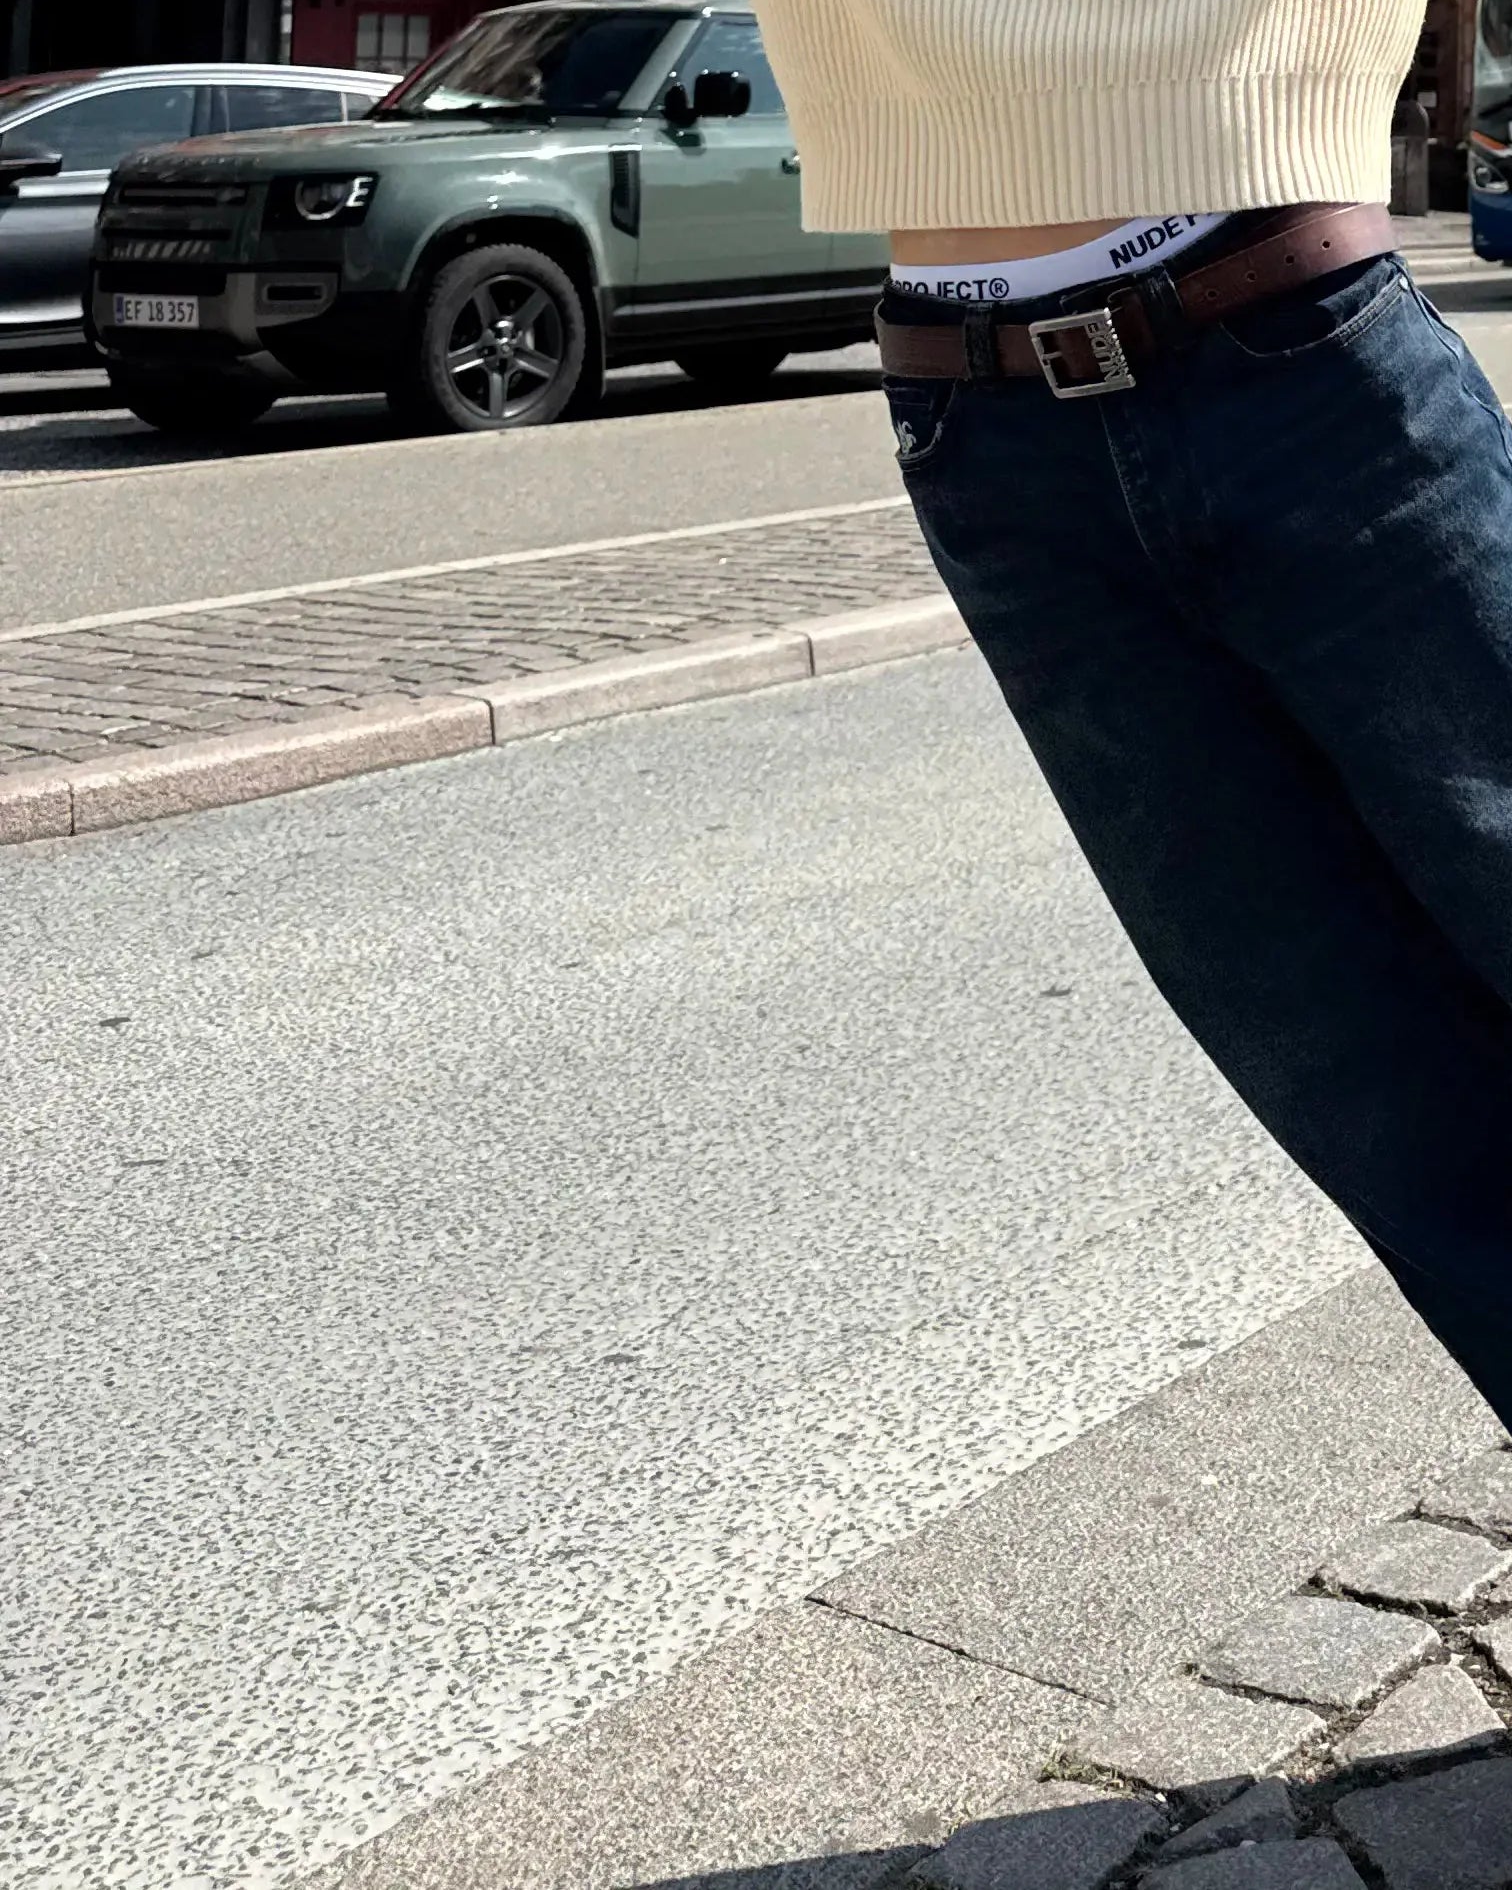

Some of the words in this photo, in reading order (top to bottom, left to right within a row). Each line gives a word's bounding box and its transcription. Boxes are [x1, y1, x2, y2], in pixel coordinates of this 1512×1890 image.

[1108, 215, 1185, 270] NUDE
[125, 299, 143, 321] EF
[147, 300, 165, 322] 18
[167, 301, 195, 323] 357
